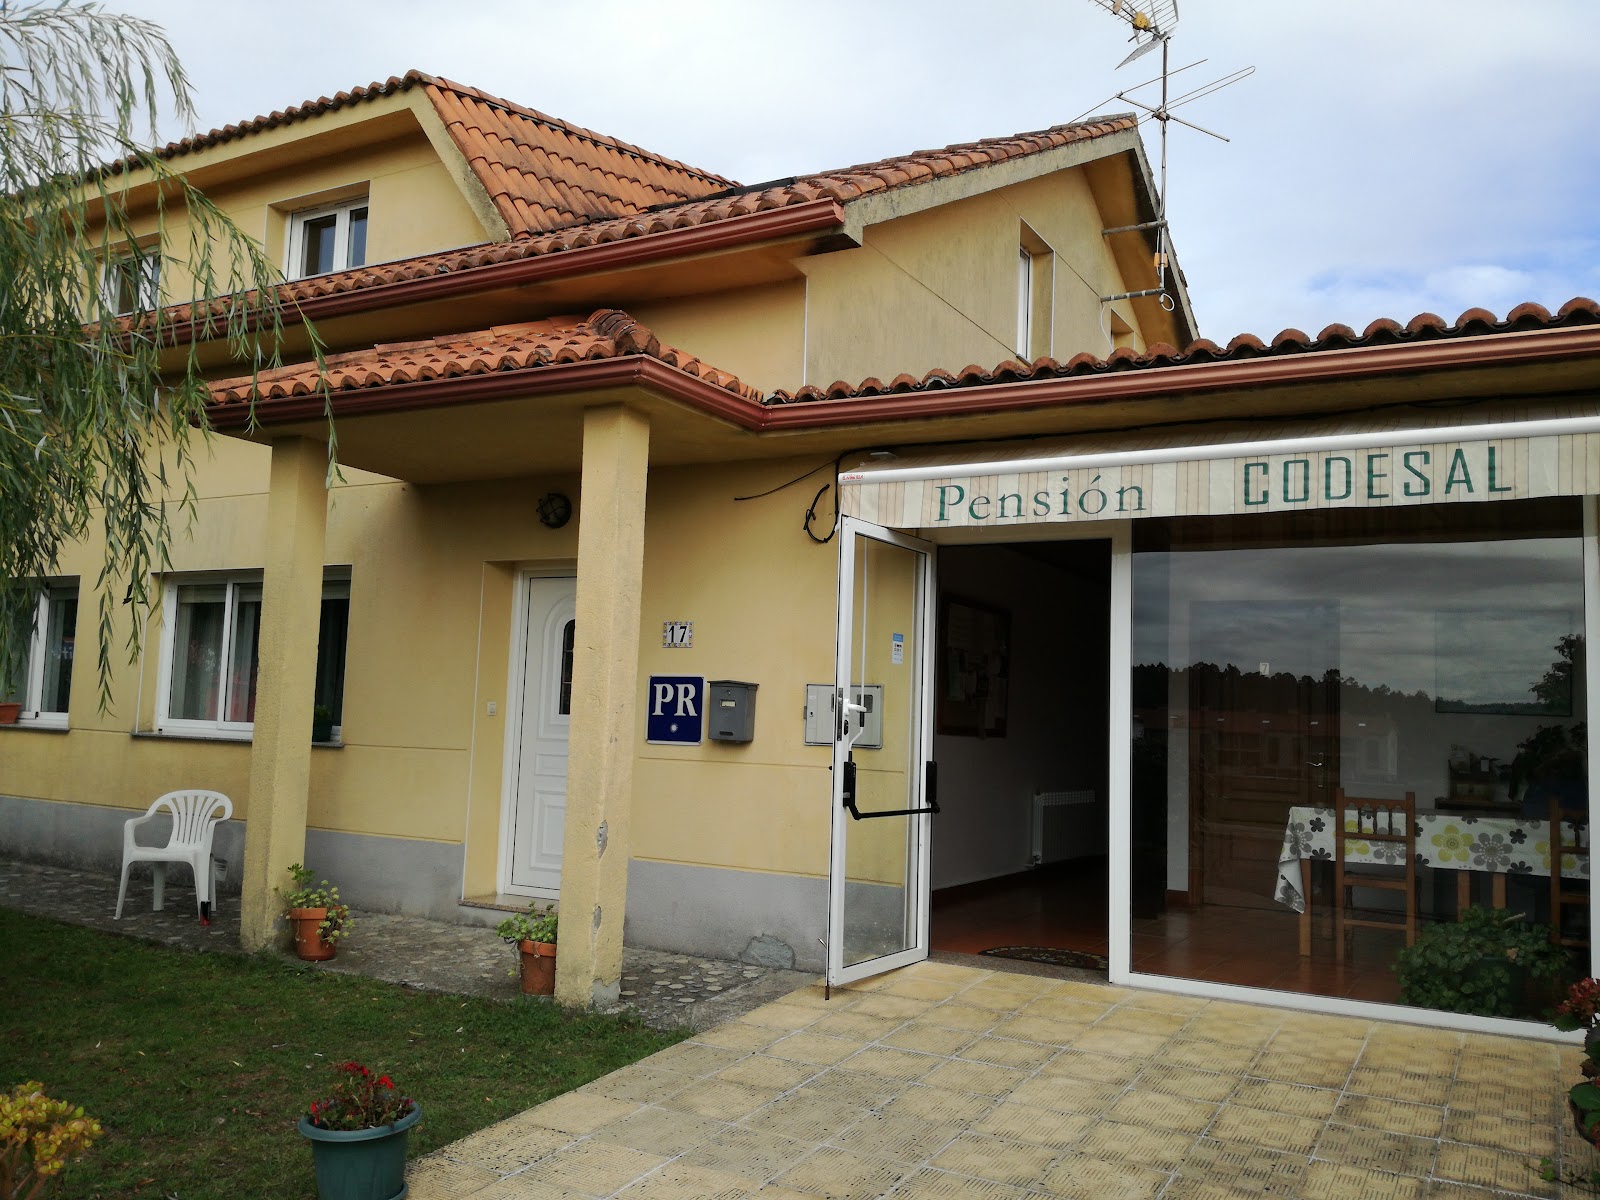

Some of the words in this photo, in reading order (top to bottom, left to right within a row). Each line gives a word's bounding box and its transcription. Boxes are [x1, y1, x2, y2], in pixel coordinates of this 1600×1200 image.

[934, 475, 1147, 522] Pensión
[1244, 446, 1512, 506] CODESAL
[668, 625, 688, 643] 17
[651, 683, 698, 717] PR
